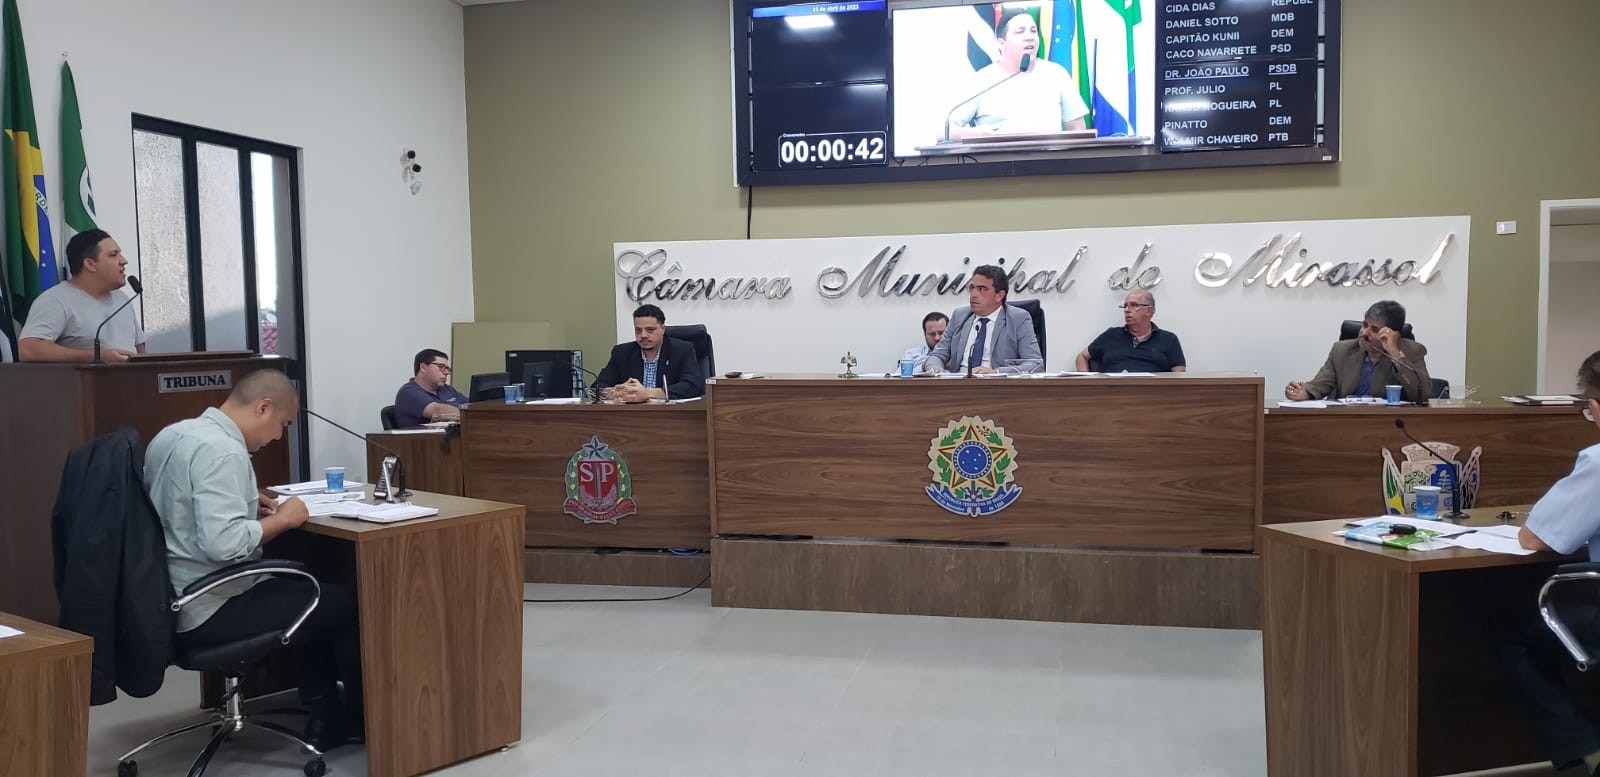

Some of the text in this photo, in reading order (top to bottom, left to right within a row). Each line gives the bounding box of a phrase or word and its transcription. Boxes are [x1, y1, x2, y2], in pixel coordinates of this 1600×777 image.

[1166, 2, 1216, 13] CIDA DIAS
[1271, 12, 1295, 22] MDB
[1166, 16, 1239, 29] DANIEL SOTTO
[1166, 32, 1240, 44] CAPITÃO KUNII
[1272, 29, 1294, 38] DEM
[1166, 46, 1257, 59] CACO NAVARRETE
[1271, 44, 1291, 53] PSD
[1165, 66, 1249, 78] DR. JOÃO PAULO
[1269, 64, 1297, 73] PSDB
[1165, 85, 1225, 96] PROF. JULIO
[1269, 82, 1282, 91] PL
[1269, 100, 1282, 108] PL
[1164, 120, 1207, 129] PINATTO
[1269, 116, 1291, 126] DEM
[1207, 134, 1258, 144] CHAVEIRO
[1268, 133, 1288, 142] PTB
[781, 138, 884, 163] 00:00:42
[616, 231, 1456, 305] Câmara Munipal de Mirassol
[164, 374, 226, 388] TRIBUNA
